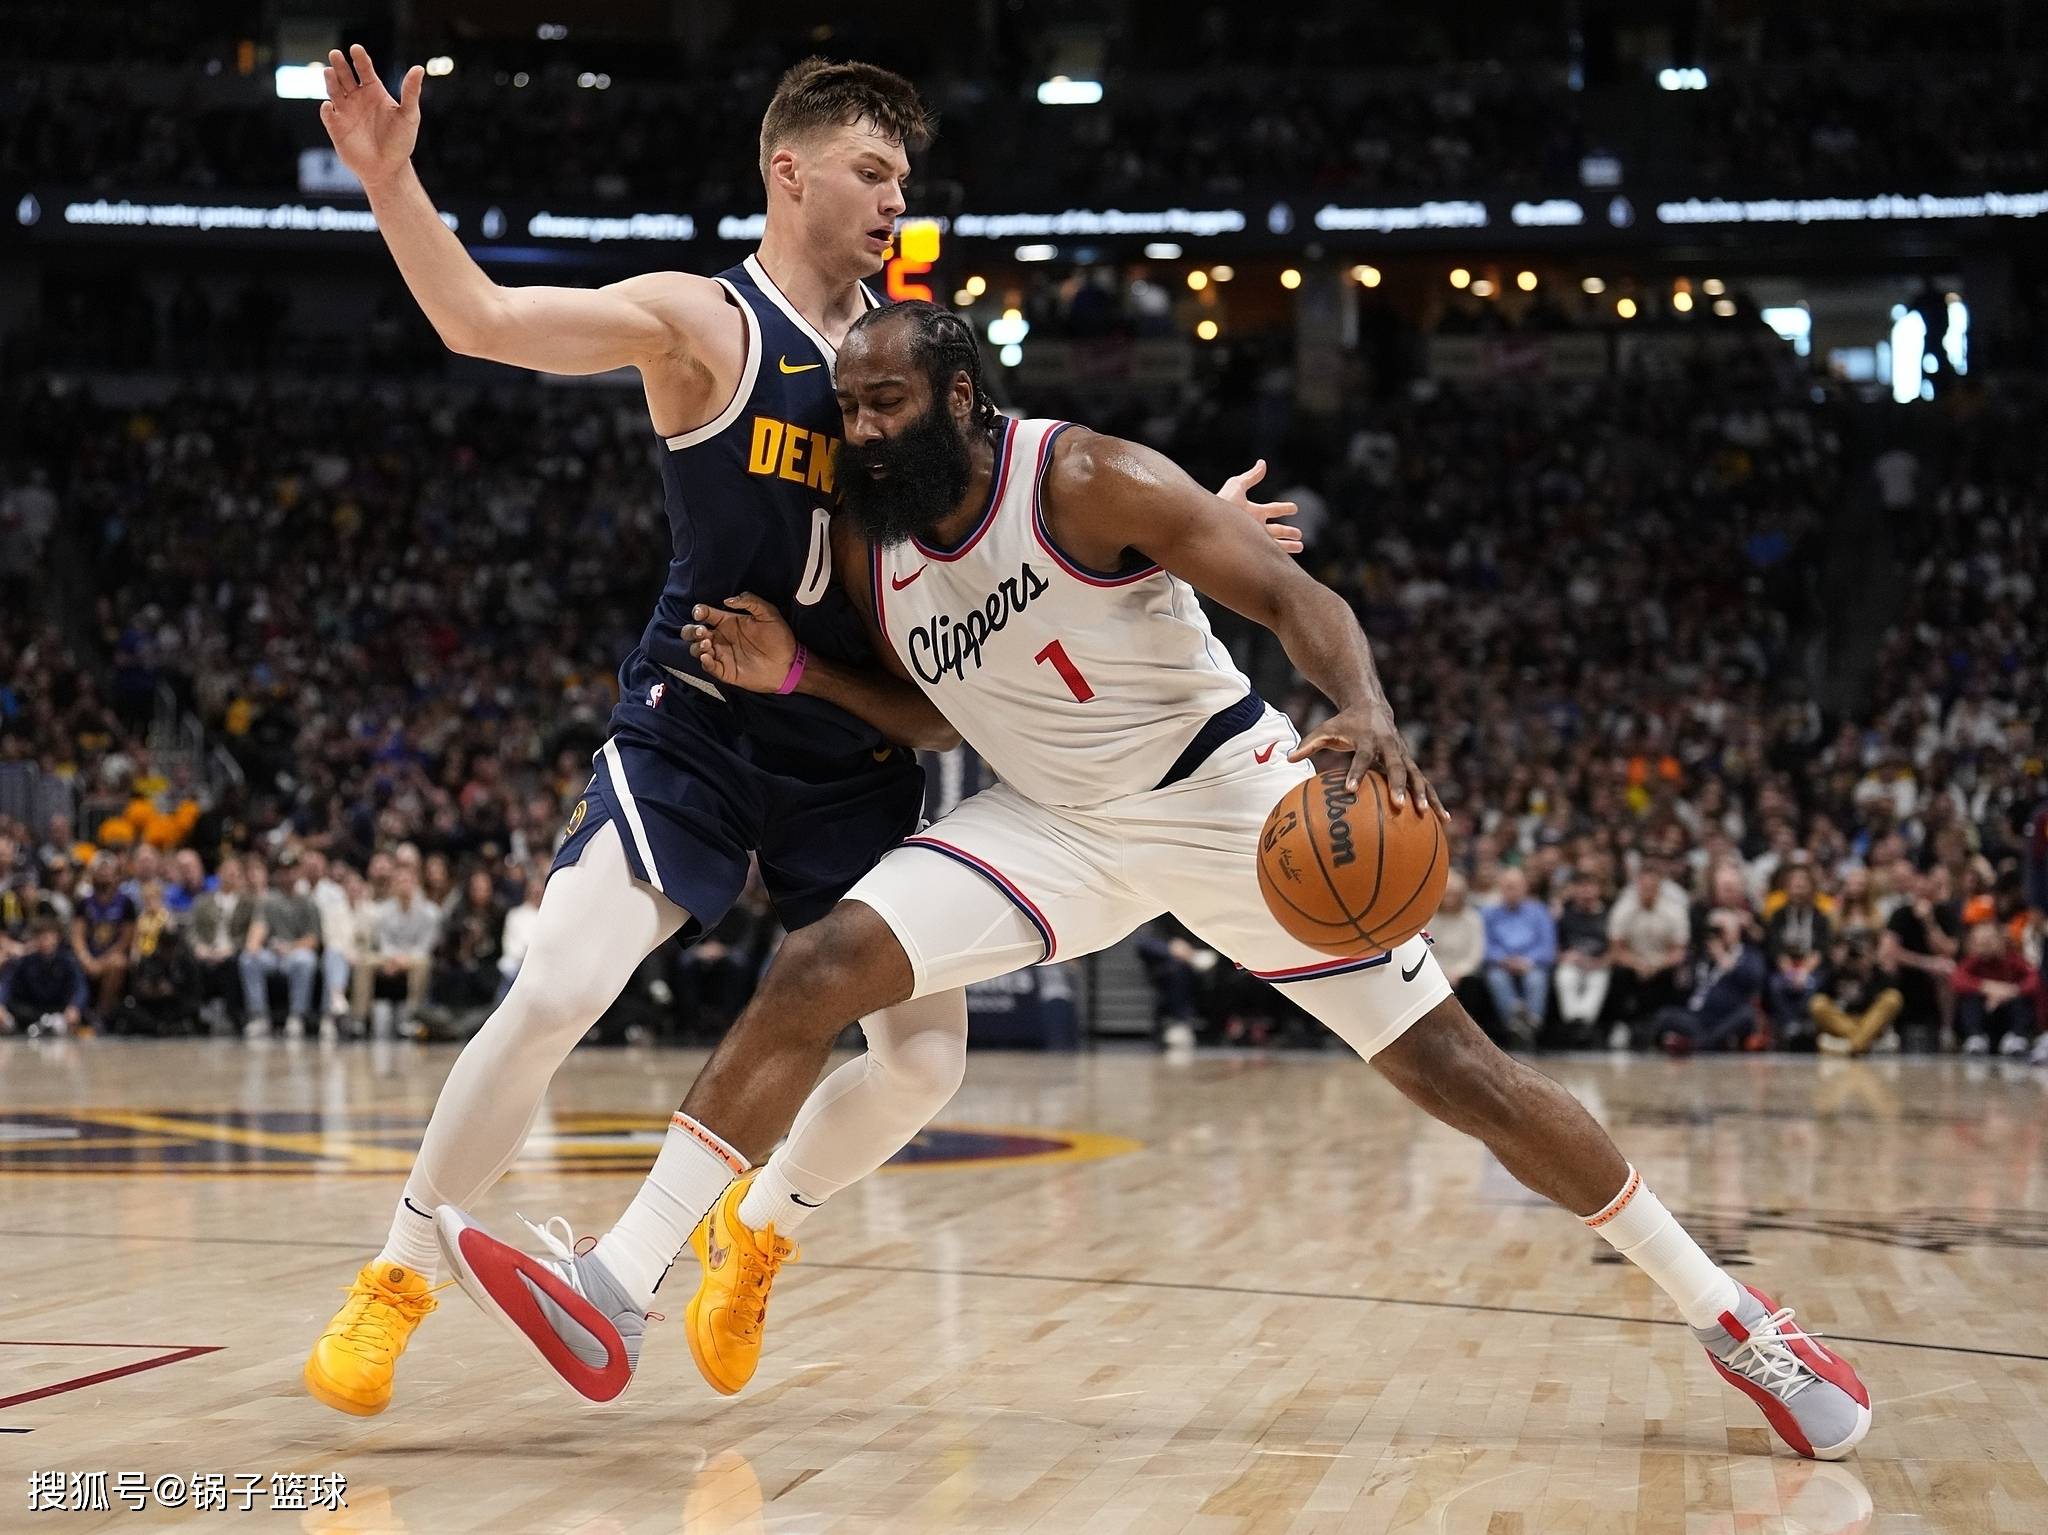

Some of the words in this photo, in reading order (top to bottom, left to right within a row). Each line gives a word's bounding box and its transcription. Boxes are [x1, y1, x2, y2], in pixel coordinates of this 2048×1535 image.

[748, 416, 842, 497] DEN
[795, 508, 832, 606] 0
[908, 562, 1049, 685] Clippers
[1034, 639, 1095, 703] 1
